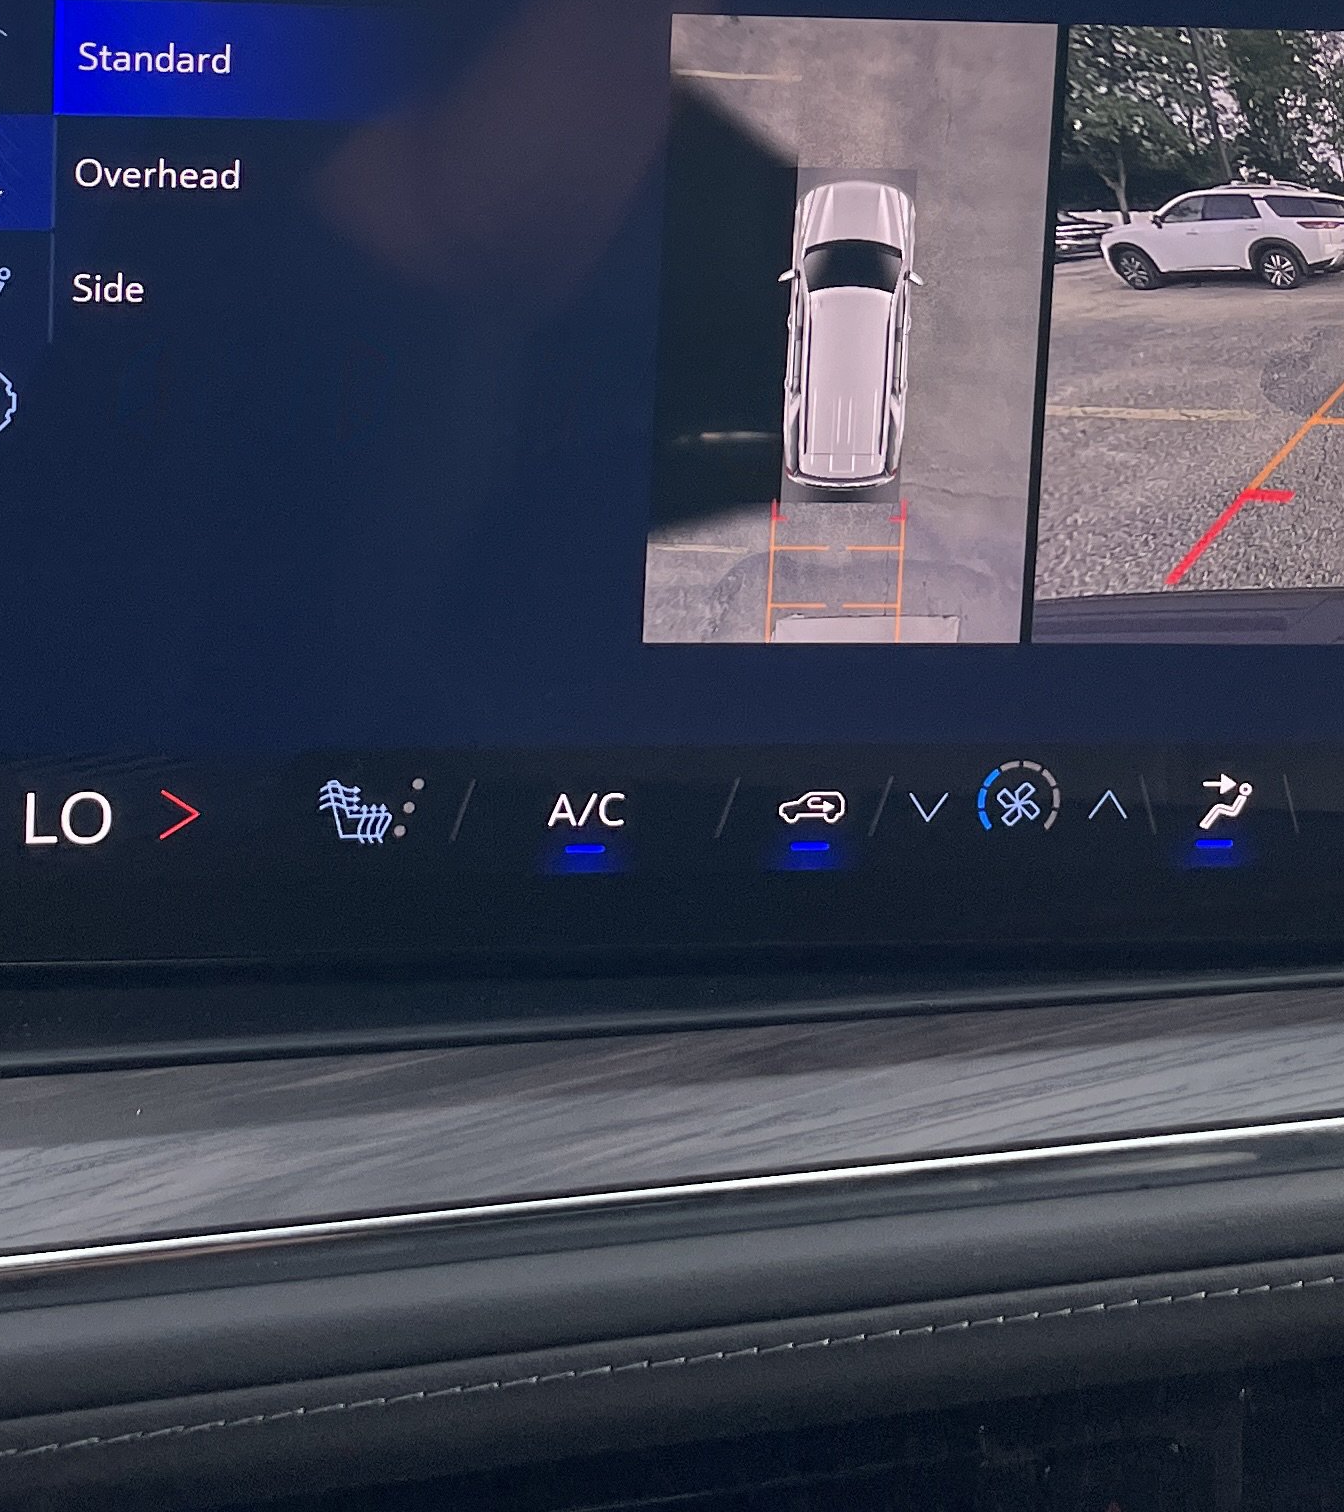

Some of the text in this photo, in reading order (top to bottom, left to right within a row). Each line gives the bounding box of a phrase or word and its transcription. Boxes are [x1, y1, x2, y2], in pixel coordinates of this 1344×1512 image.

[78, 42, 232, 74] Standard
[74, 157, 241, 190] Overhead
[72, 272, 144, 303] Side
[24, 791, 112, 845] LO
[547, 792, 625, 827] A/C
